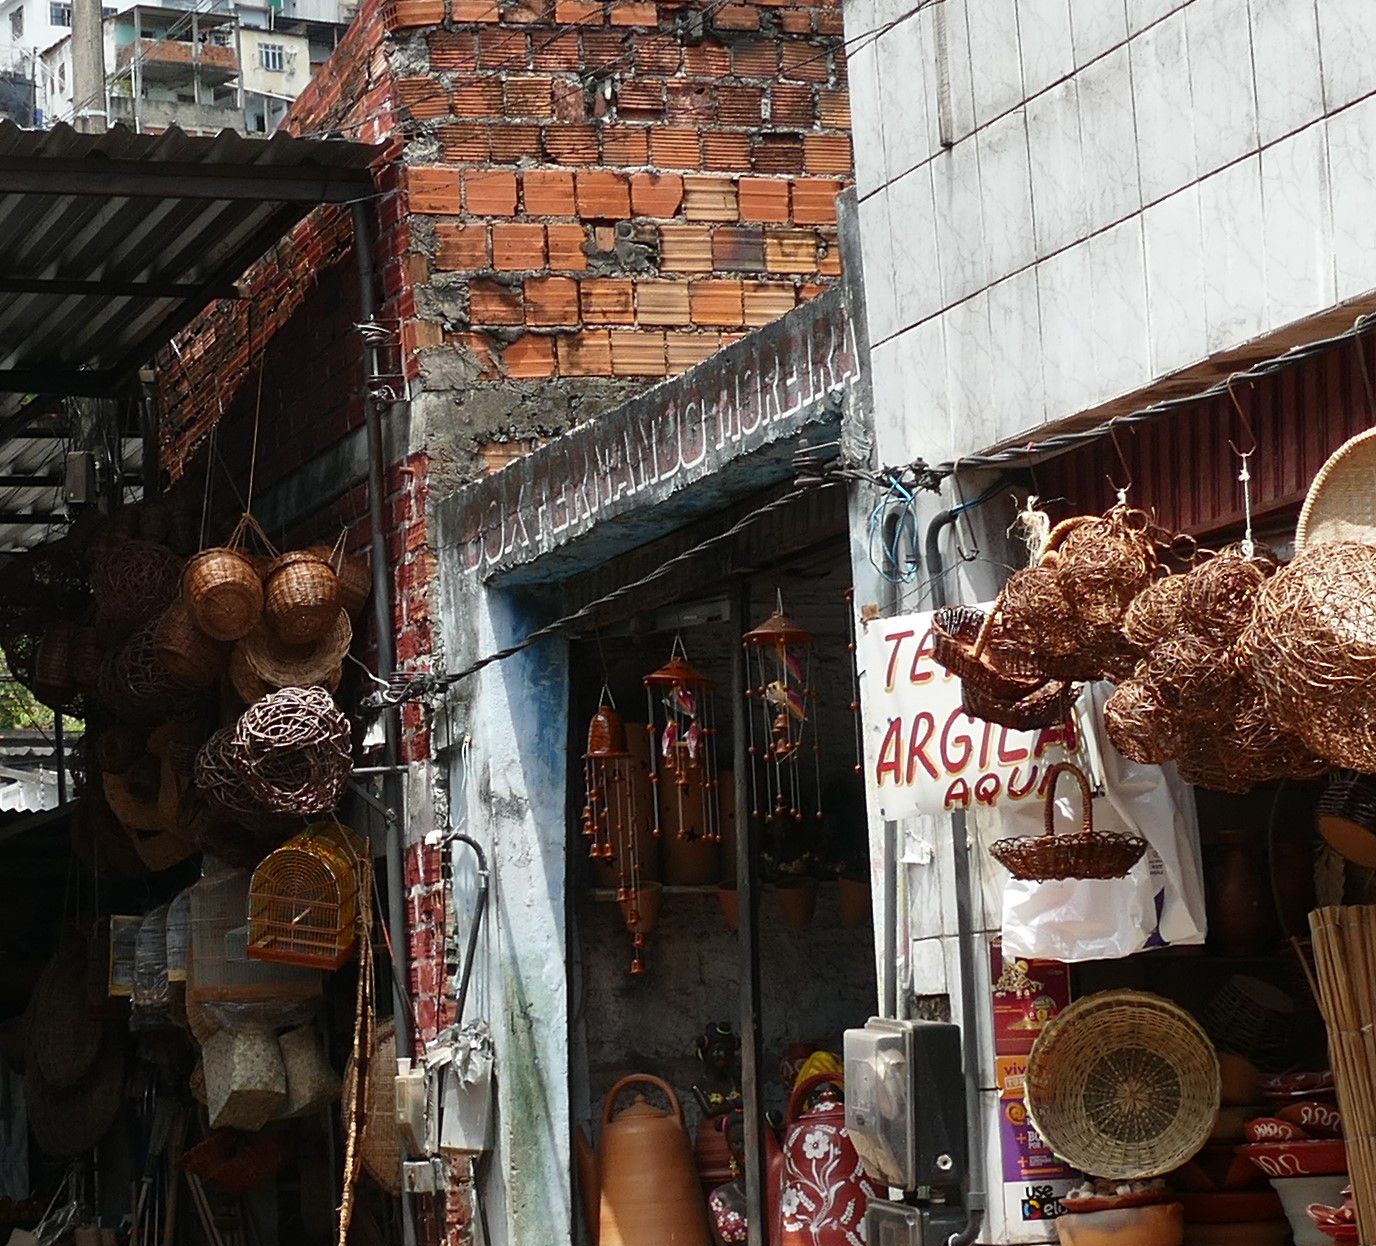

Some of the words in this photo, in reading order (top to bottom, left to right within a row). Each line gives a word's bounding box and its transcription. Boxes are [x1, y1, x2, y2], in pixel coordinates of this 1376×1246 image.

[534, 385, 707, 543] FERNANDO
[713, 306, 861, 450] MOREIRA
[885, 629, 953, 690] TE
[876, 704, 1080, 787] ARGILA
[1004, 1062, 1027, 1076] viv
[1025, 1185, 1054, 1199] use
